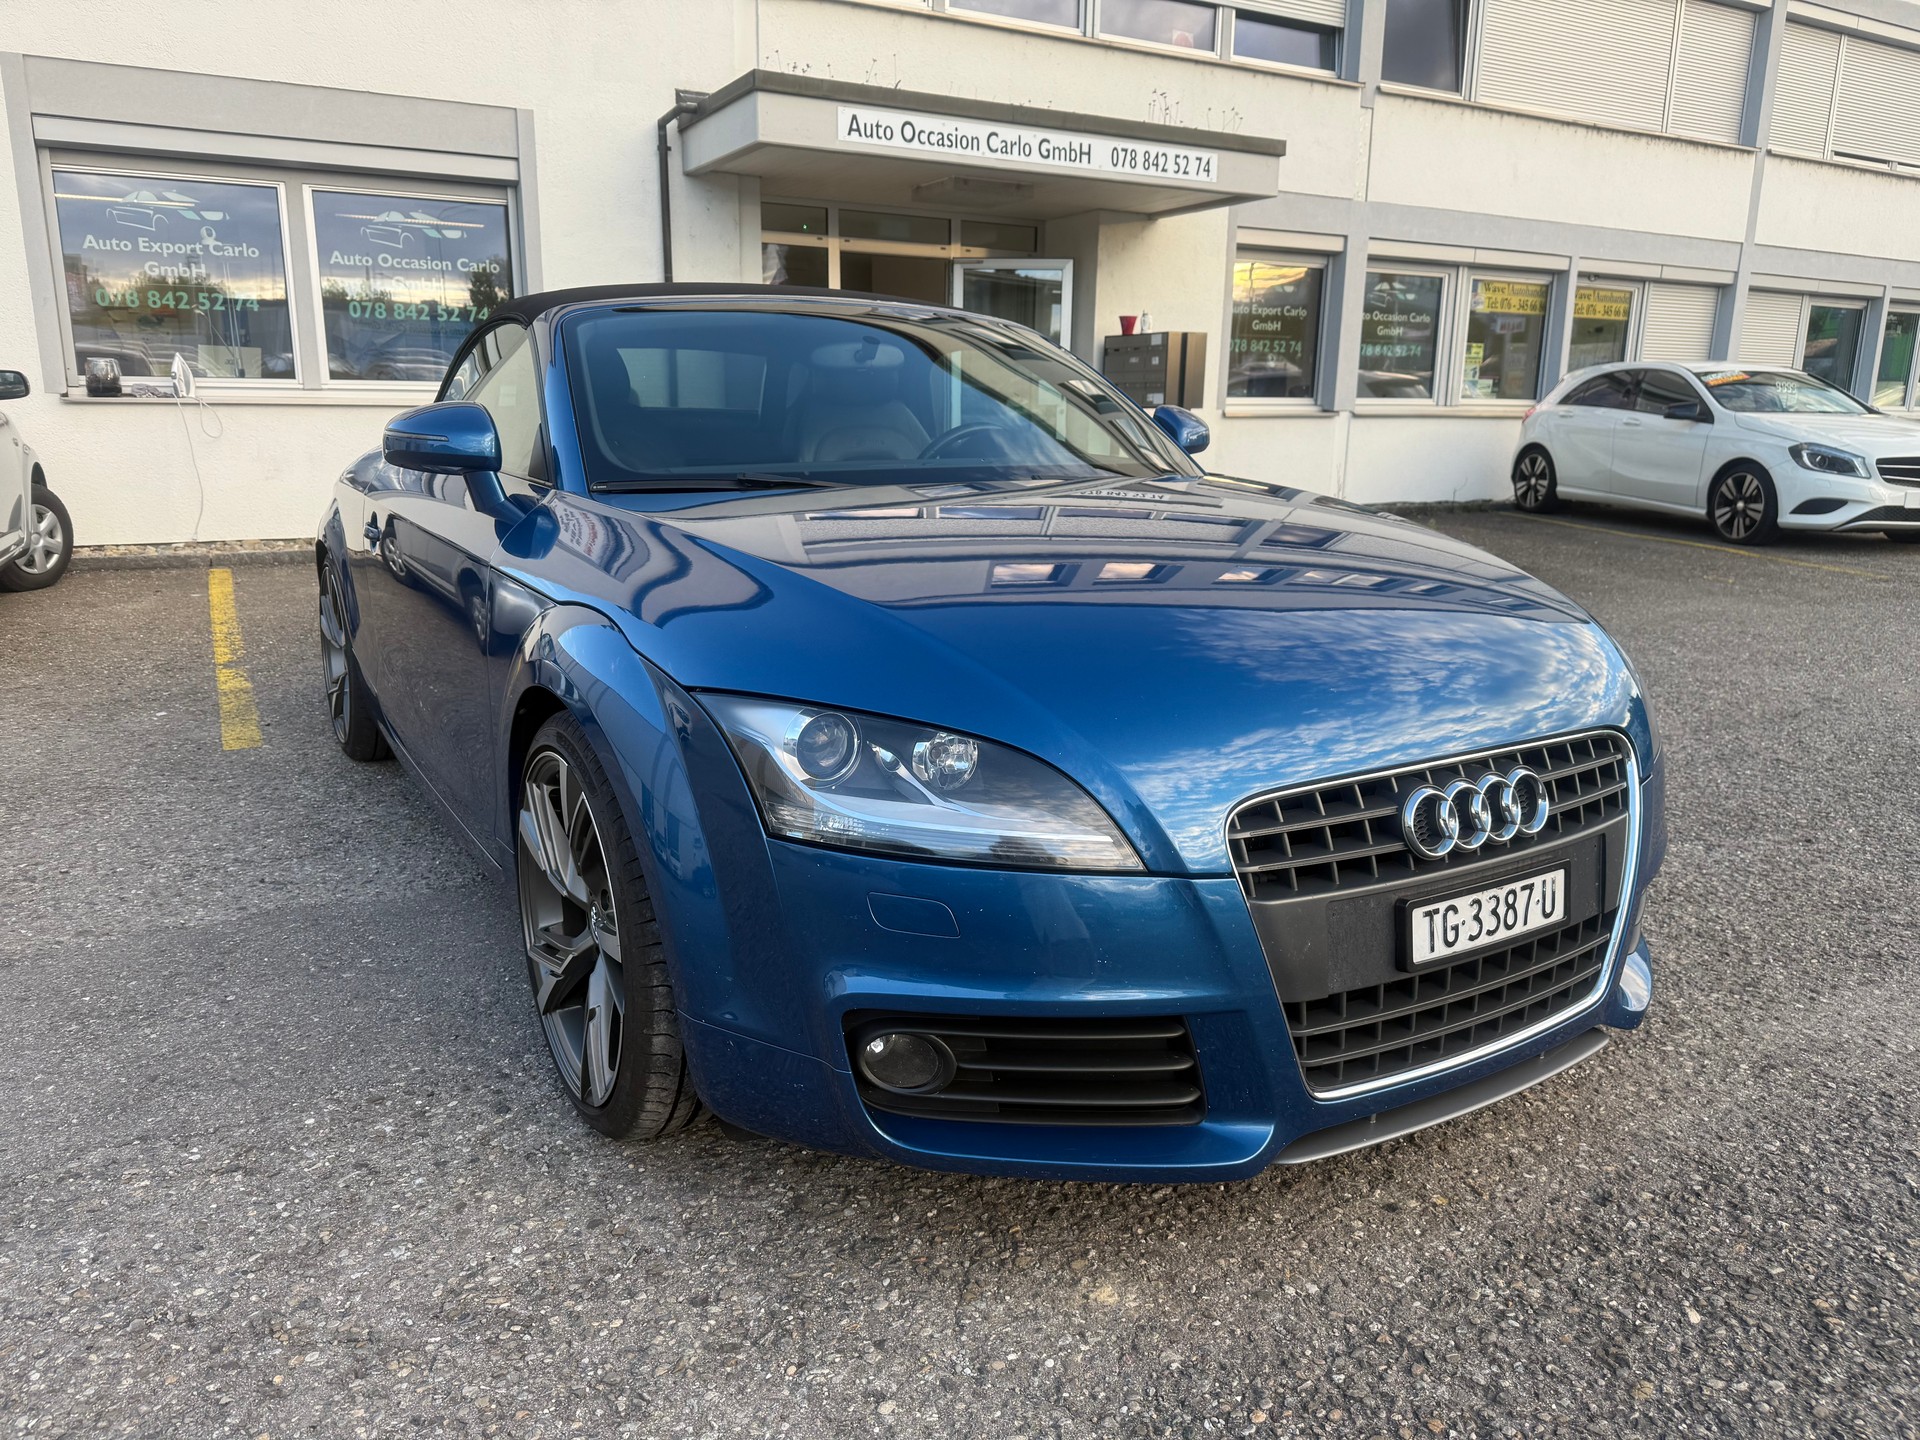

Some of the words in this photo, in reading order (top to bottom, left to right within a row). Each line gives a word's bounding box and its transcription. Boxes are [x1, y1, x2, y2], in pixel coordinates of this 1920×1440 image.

[847, 114, 894, 141] Auto
[901, 120, 980, 152] Occasion
[986, 131, 1032, 158] Carlo
[1038, 138, 1092, 165] GmbH
[1111, 147, 1137, 169] 078
[1143, 151, 1168, 173] 842
[1173, 154, 1190, 175] 52
[1195, 157, 1212, 178] 74
[83, 234, 132, 251] Auto
[138, 237, 204, 257] Export
[209, 242, 260, 258] Carlo
[144, 261, 206, 278] GmbH
[330, 250, 373, 267] Auto
[378, 253, 452, 271] Occasion
[457, 258, 500, 274] Carlo
[147, 290, 190, 309] 842
[199, 292, 225, 311] 52
[350, 301, 387, 319] 078
[393, 303, 430, 320] 842
[437, 306, 461, 322] 52
[467, 307, 489, 322] 74
[1252, 304, 1281, 318] Export
[1283, 305, 1307, 317] Carlo
[1372, 311, 1408, 322] Occasion
[1410, 312, 1431, 323] Carlo
[1252, 320, 1281, 331] GmbH
[1377, 326, 1403, 336] GmbH
[1250, 340, 1270, 353] 842
[1273, 340, 1286, 353] 52
[1289, 341, 1302, 353] 74
[1375, 344, 1393, 357] 842
[1395, 345, 1408, 357] 52
[1410, 345, 1422, 357] 74
